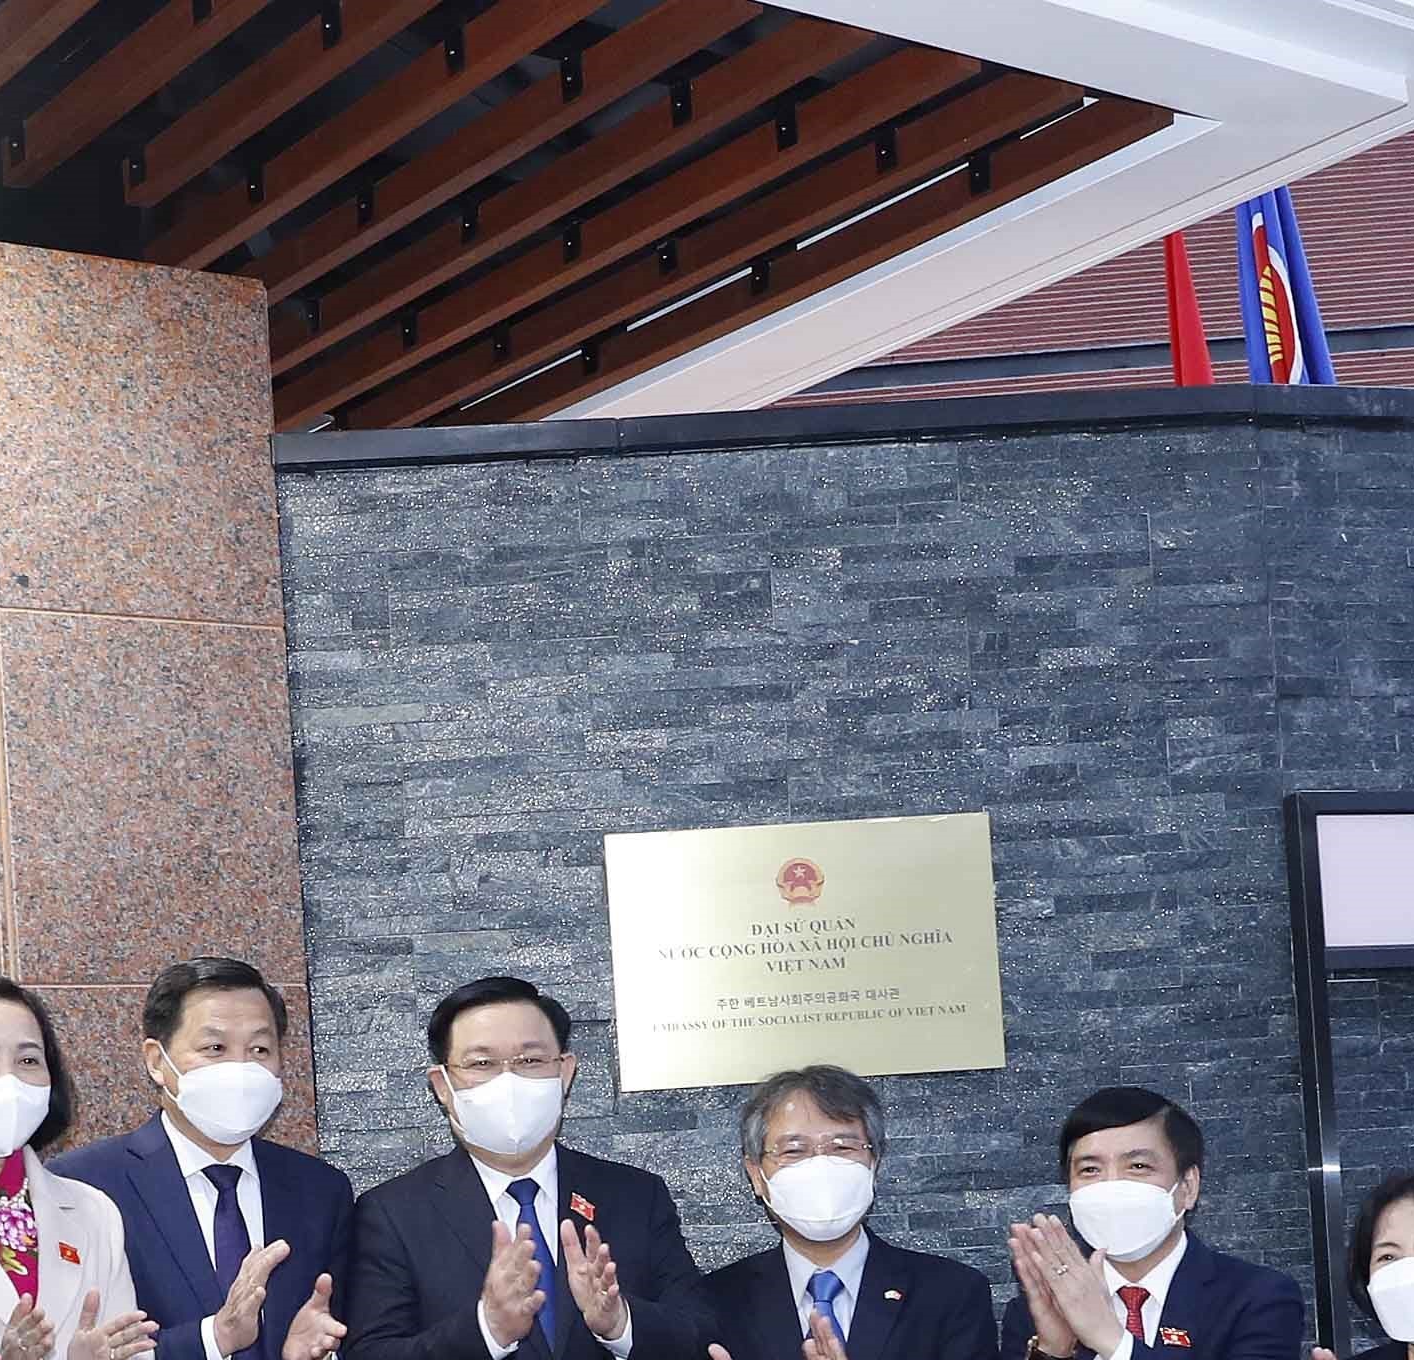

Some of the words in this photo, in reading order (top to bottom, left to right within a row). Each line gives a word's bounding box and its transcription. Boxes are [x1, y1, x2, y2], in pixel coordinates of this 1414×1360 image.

[808, 956, 846, 969] NAM
[716, 997, 740, 1011] 주한
[865, 987, 900, 1001] 대사관
[712, 1019, 727, 1029] OF
[731, 1017, 756, 1028] THE
[758, 1013, 821, 1026] SOCIALIST
[825, 1009, 885, 1022] REPUBLIC
[888, 1008, 905, 1018] OF
[907, 1006, 935, 1017] VIET
[938, 1004, 967, 1015] NAM
